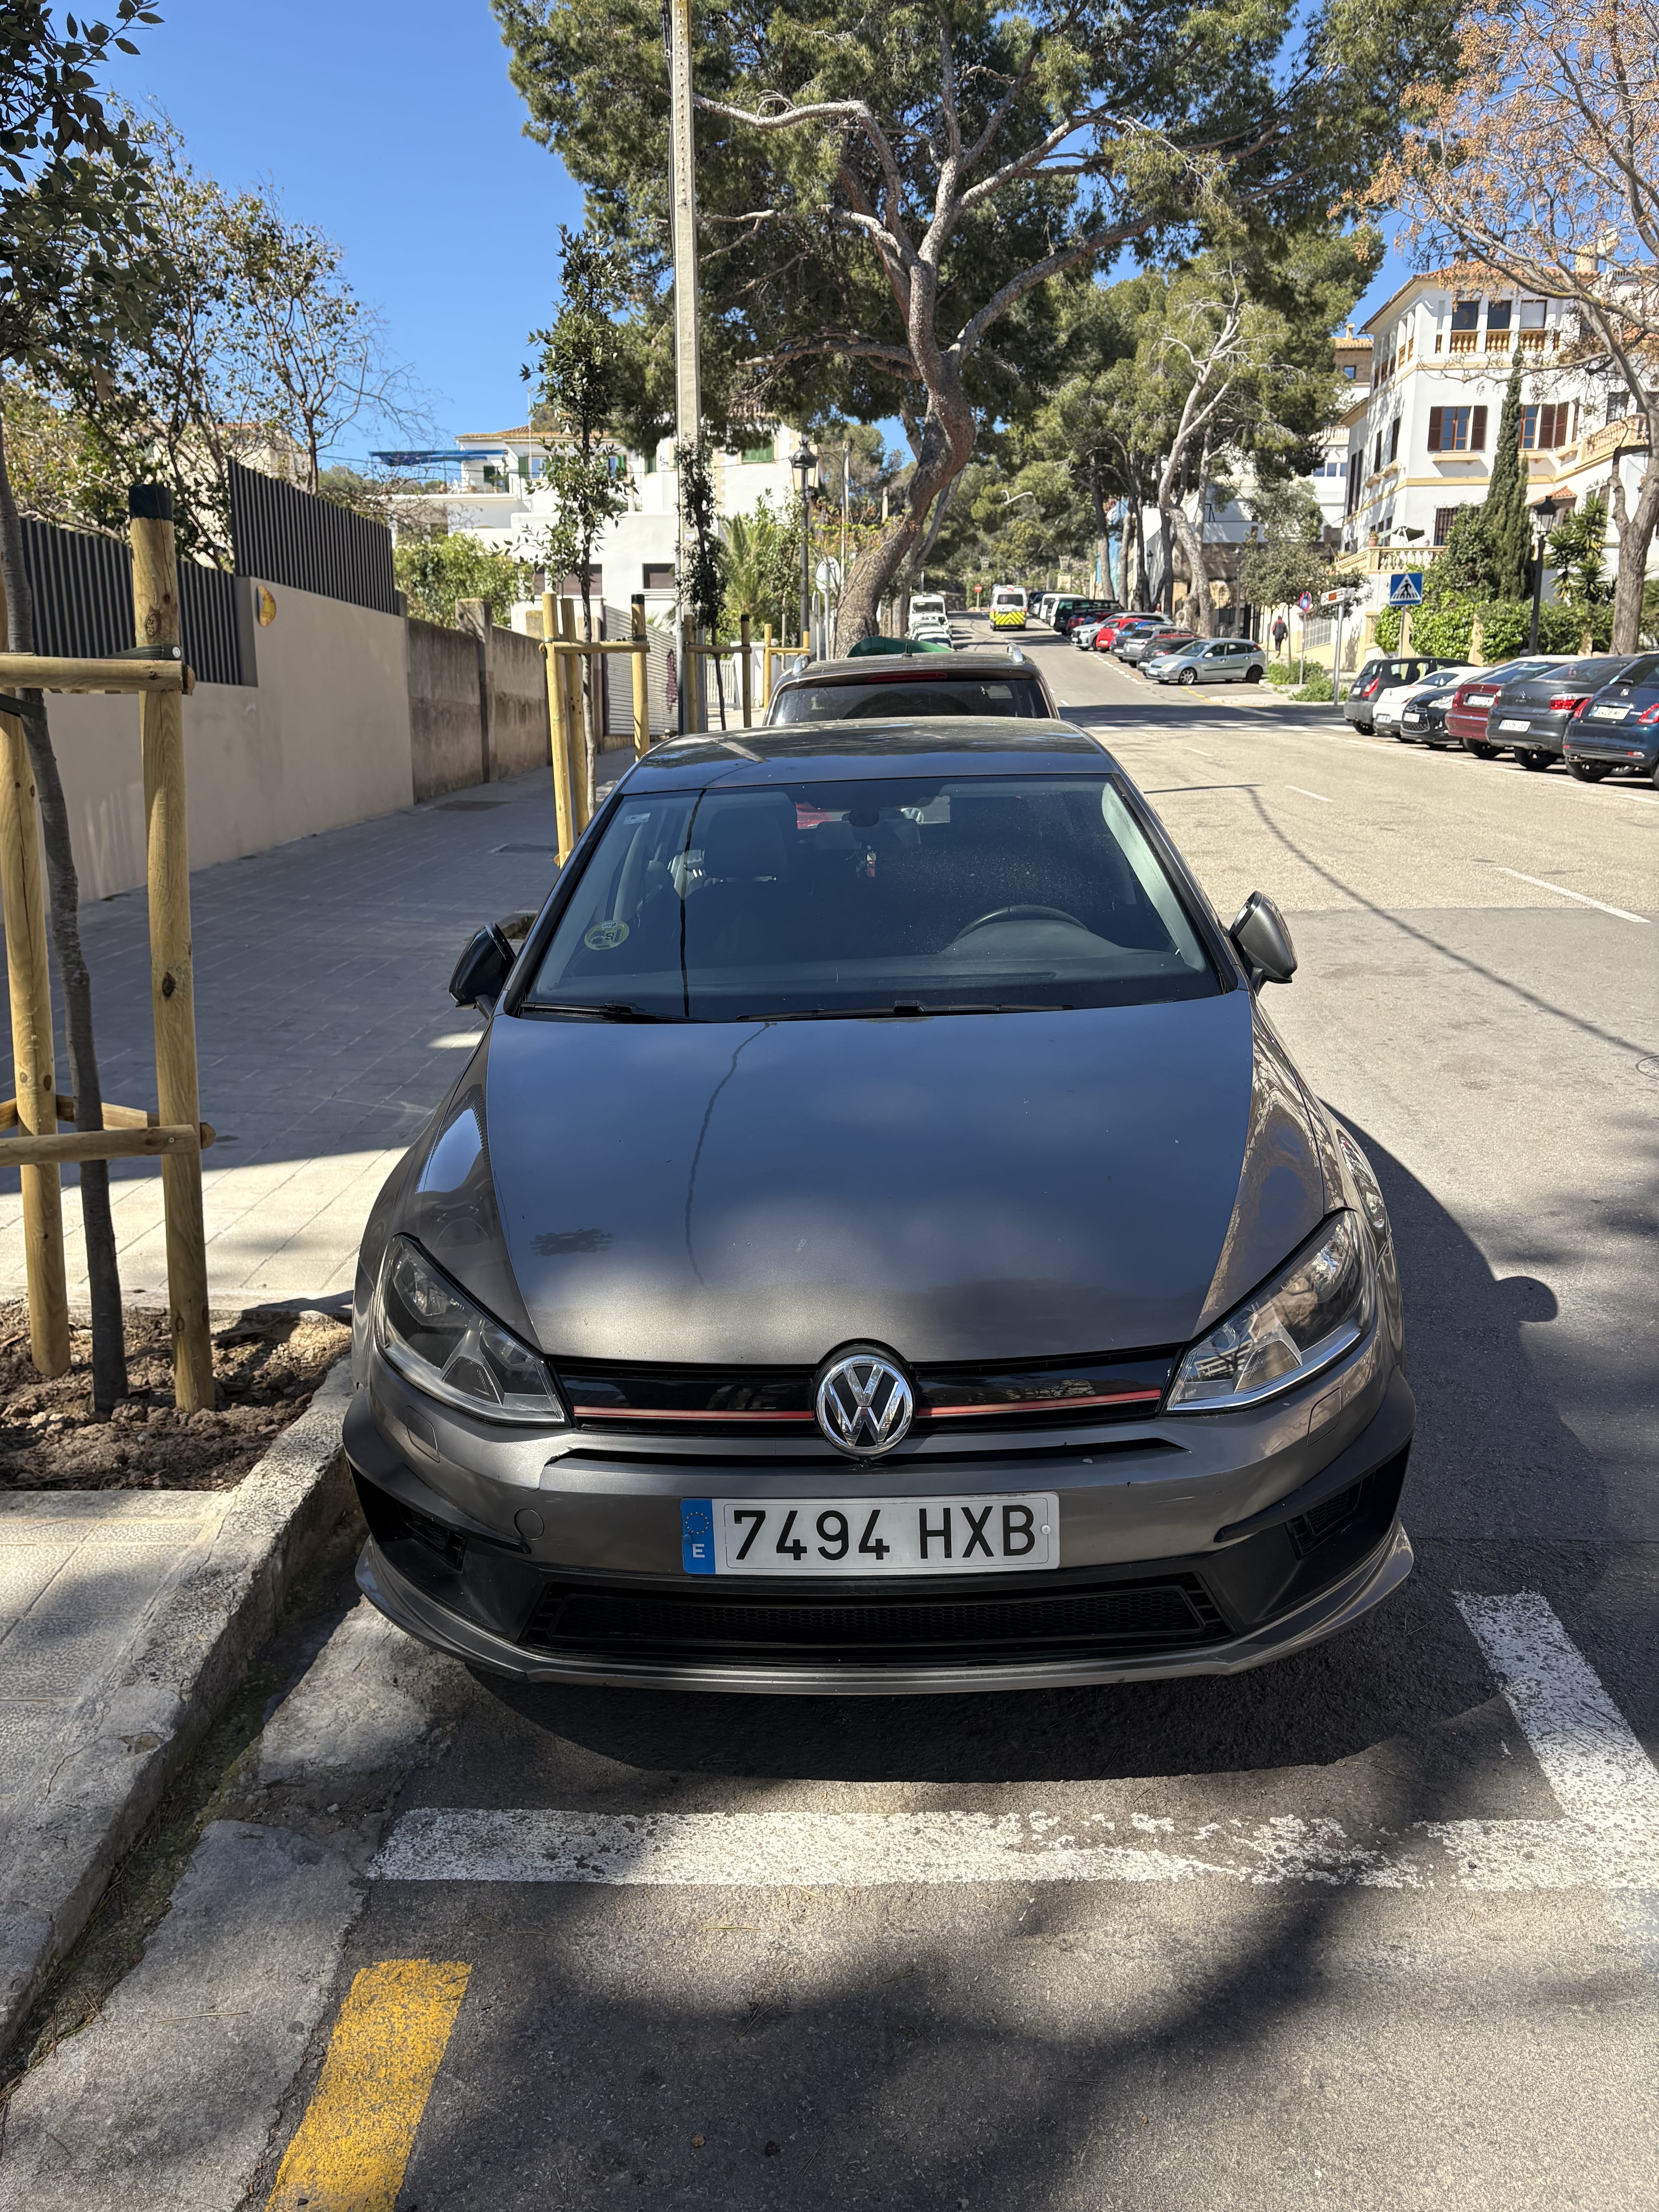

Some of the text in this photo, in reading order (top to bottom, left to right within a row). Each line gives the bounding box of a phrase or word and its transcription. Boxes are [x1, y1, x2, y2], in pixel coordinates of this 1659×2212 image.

[823, 1362, 906, 1449] VW
[692, 1544, 705, 1558] E
[734, 1505, 1035, 1561] 7494 HXB
